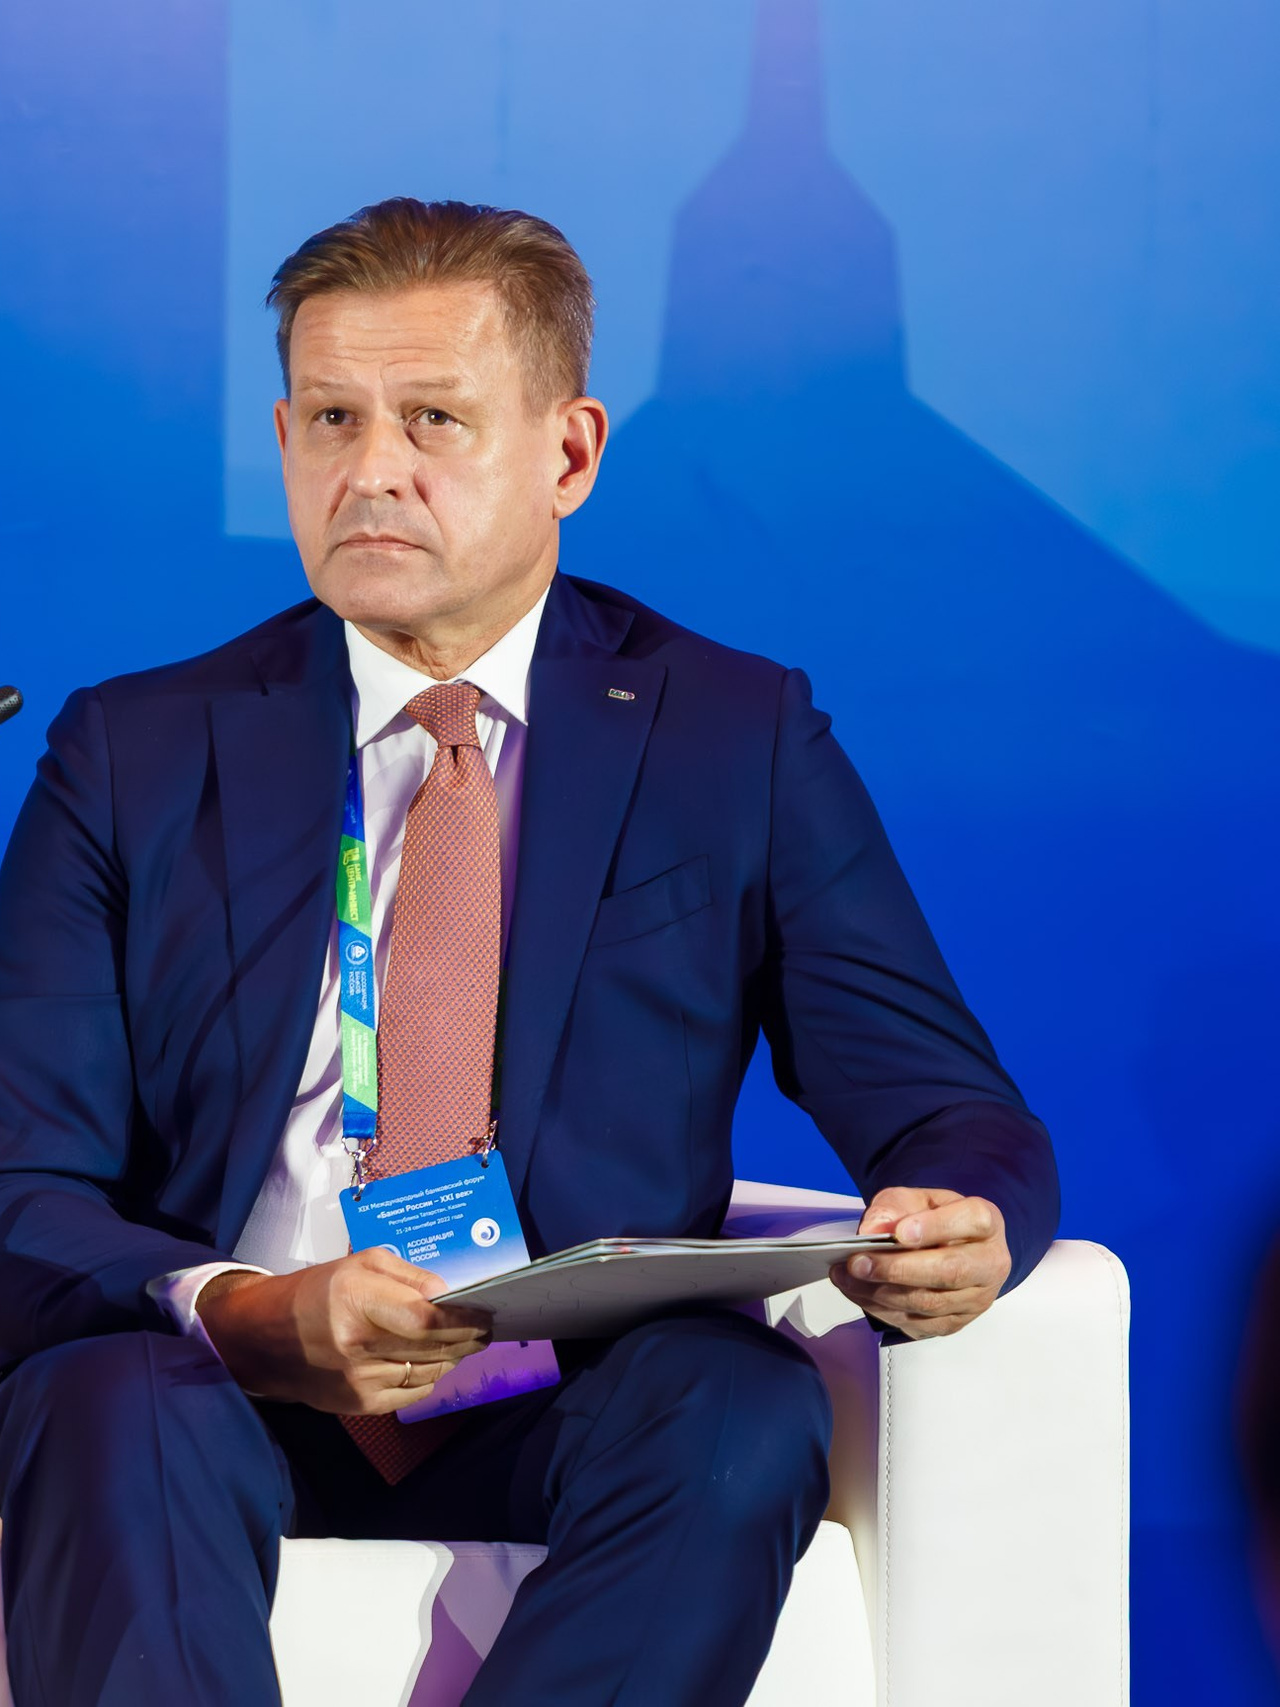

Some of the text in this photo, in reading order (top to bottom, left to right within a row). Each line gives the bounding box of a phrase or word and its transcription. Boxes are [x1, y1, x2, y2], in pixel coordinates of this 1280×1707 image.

[370, 1190, 424, 1210] Международный
[424, 1180, 463, 1196] банковский
[463, 1175, 485, 1186] форум
[376, 1207, 405, 1219] «Банки
[405, 1200, 433, 1212] России
[440, 1193, 454, 1203] XXI
[407, 1230, 455, 1249] АССОЦИАЦИЯ
[408, 1243, 437, 1256] БАНКОВ
[410, 1250, 440, 1263] РОССИИ
